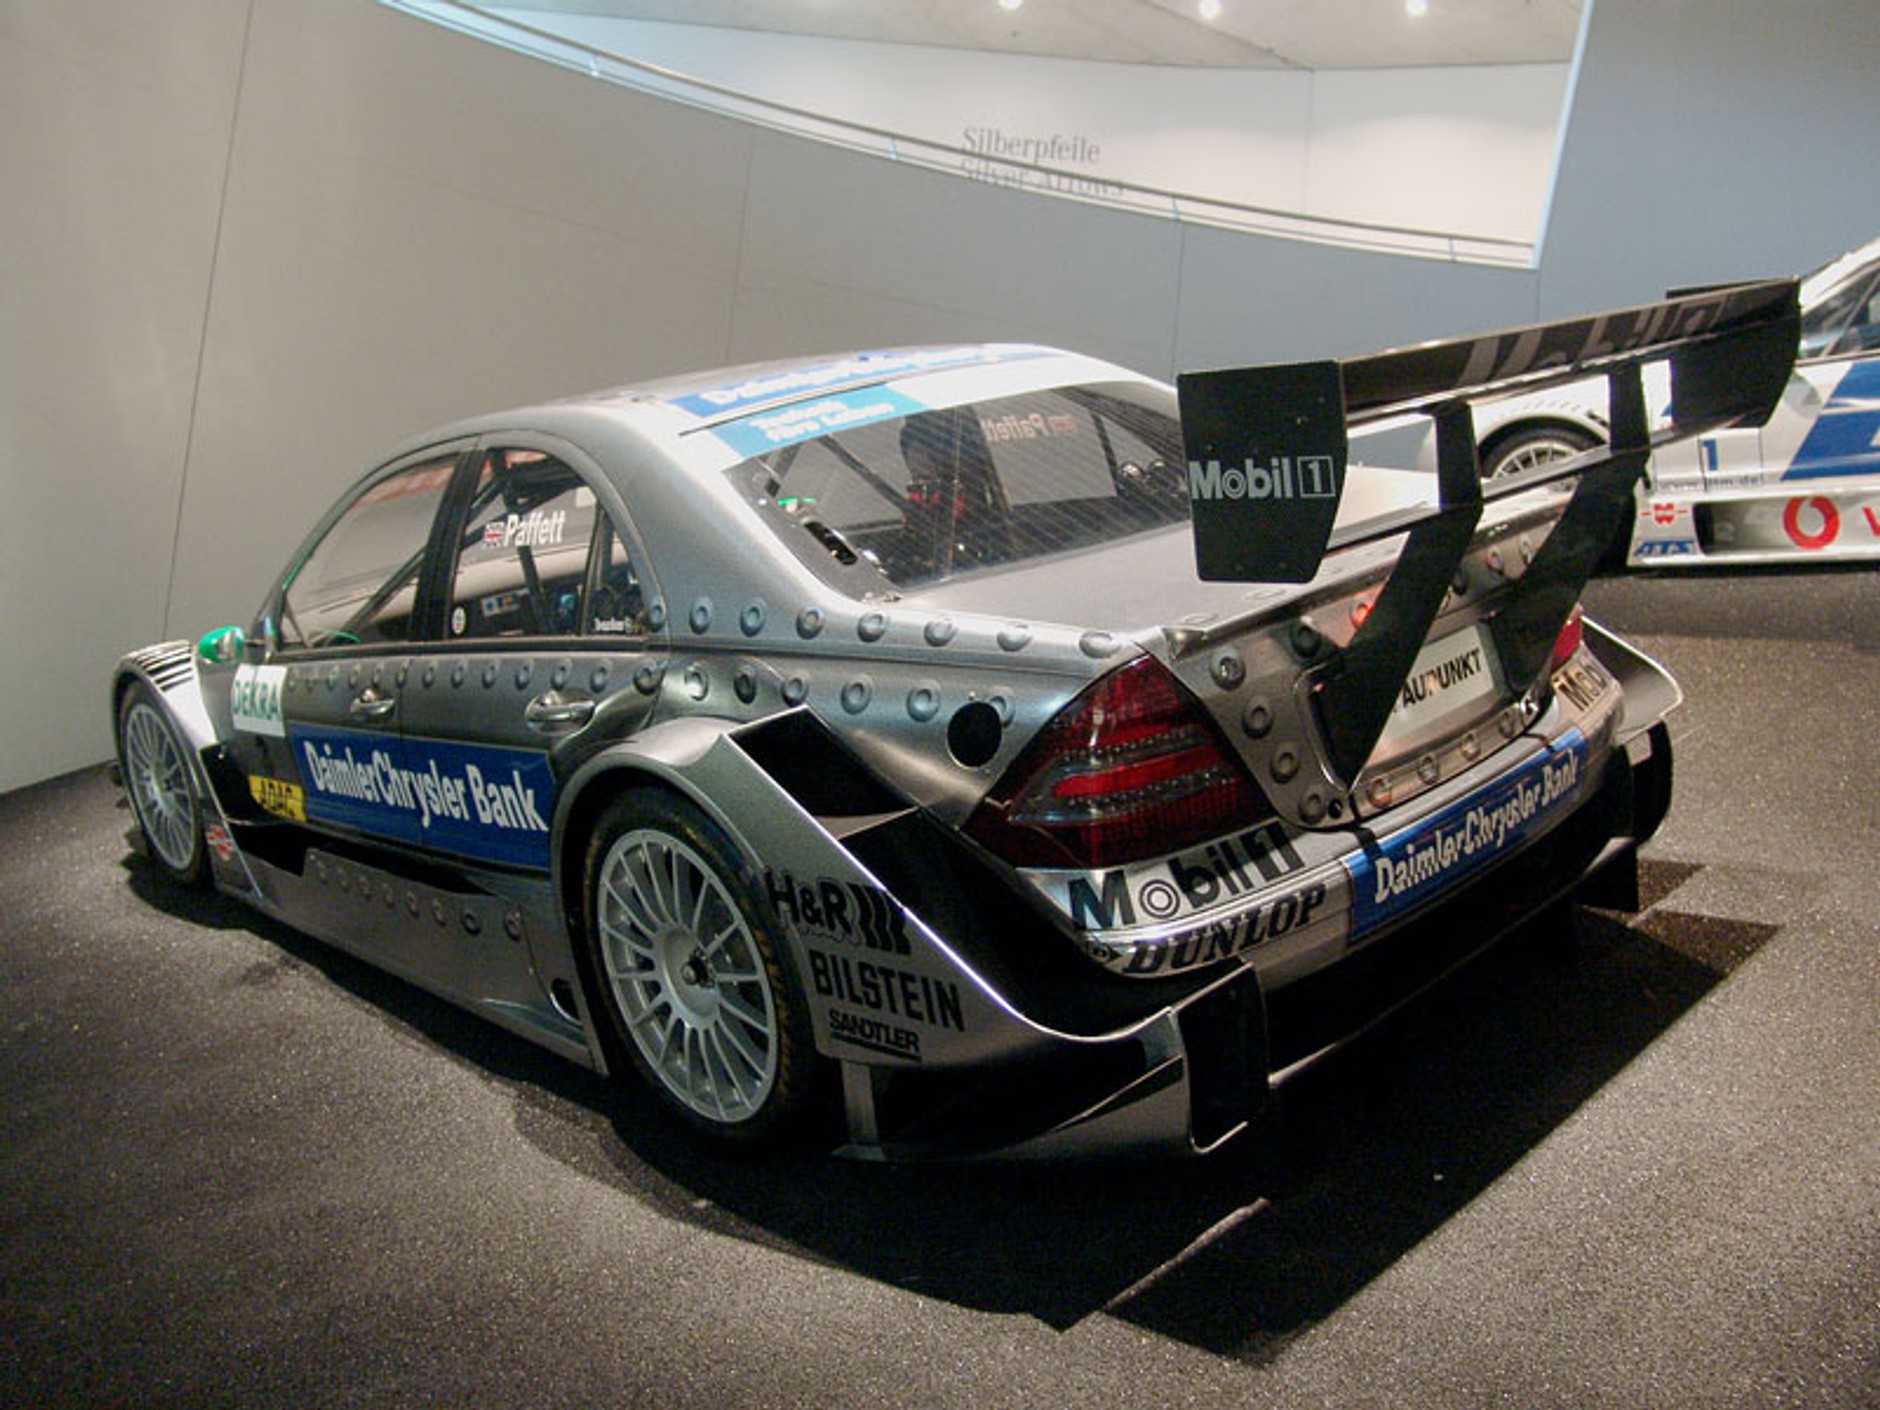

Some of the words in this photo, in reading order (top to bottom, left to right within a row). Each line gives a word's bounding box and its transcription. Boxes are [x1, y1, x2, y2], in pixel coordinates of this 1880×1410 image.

[963, 126, 1100, 164] Silberpfeile
[1188, 456, 1293, 499] Mobil
[503, 510, 565, 546] Paffett
[232, 679, 281, 721] DEKRA
[304, 740, 470, 828] DaimlerChrysler
[465, 763, 549, 832] Bank
[1375, 781, 1540, 903] DaimlerChrysler
[1541, 748, 1579, 807] Bank
[764, 867, 851, 935] H&R
[1068, 840, 1254, 930] Mobil
[1122, 884, 1327, 973] DUNLOP
[809, 949, 965, 1032] BILSTEIN
